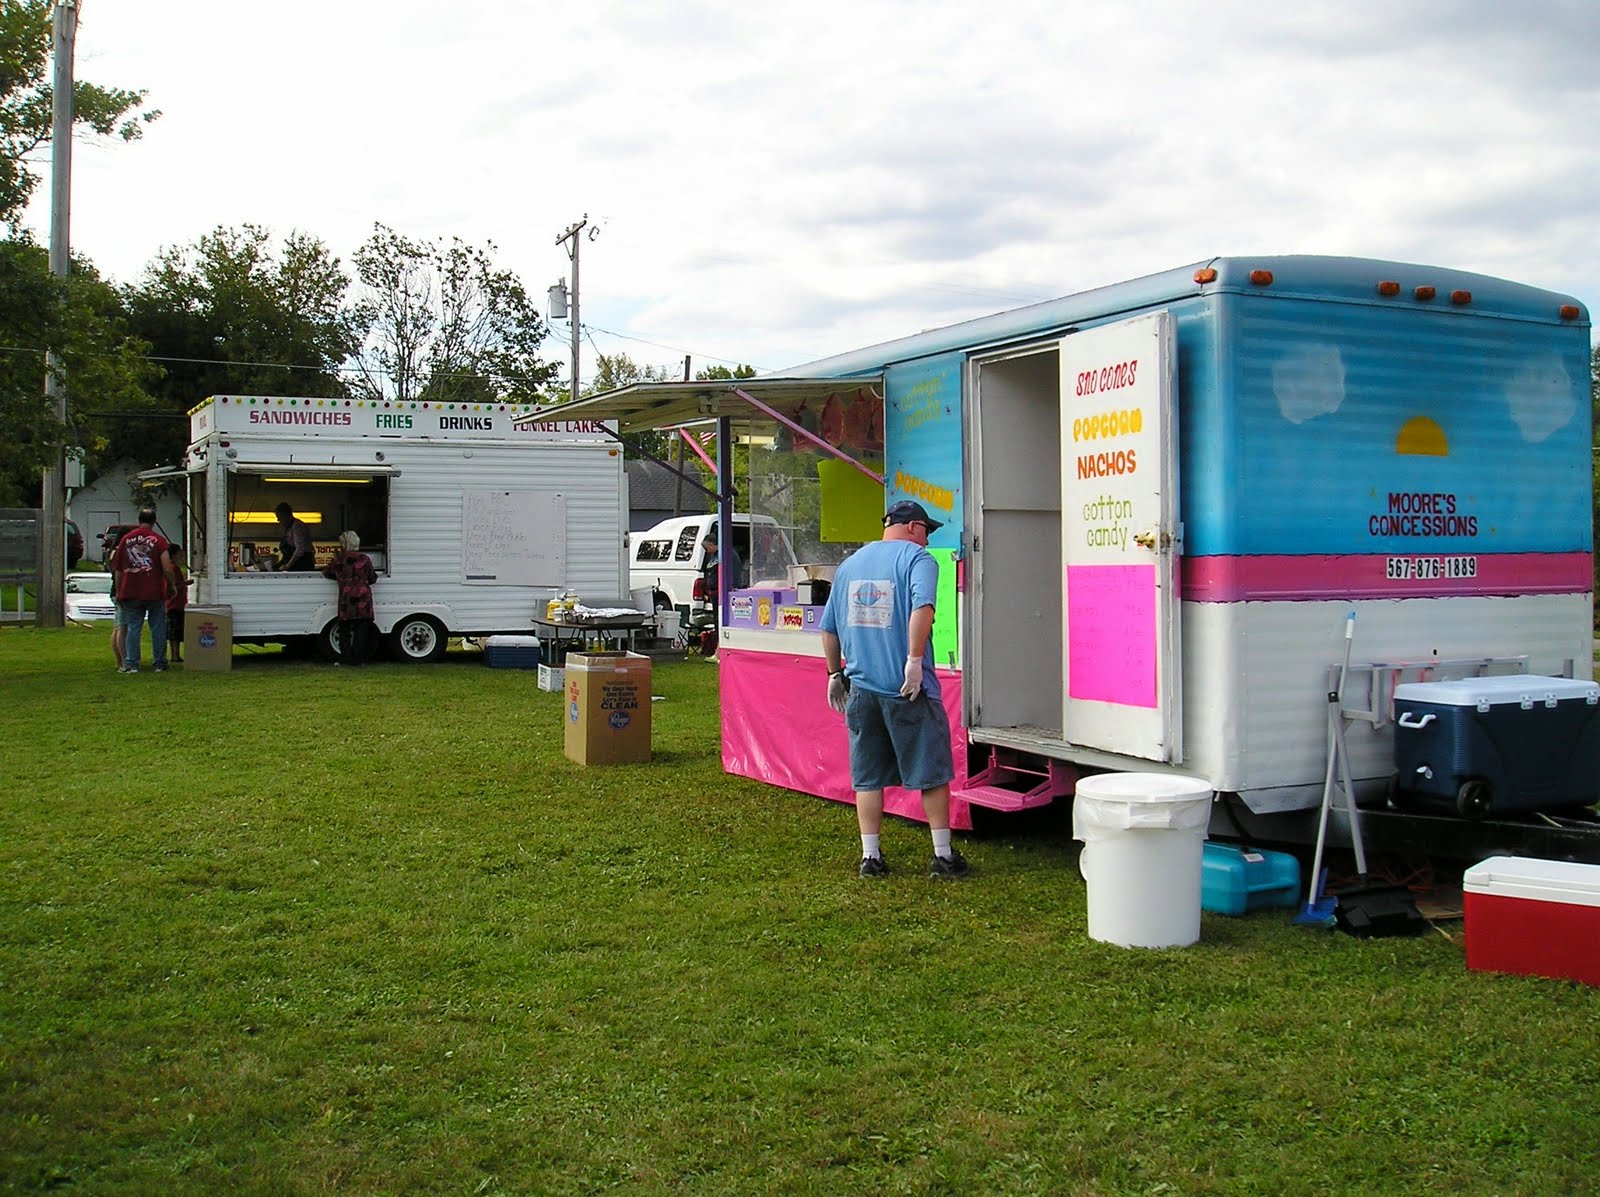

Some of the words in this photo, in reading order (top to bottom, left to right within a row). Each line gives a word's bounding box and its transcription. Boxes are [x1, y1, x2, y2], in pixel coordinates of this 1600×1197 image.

[249, 410, 351, 425] SANDWICHES
[376, 413, 413, 429] FRIES
[439, 415, 493, 431] DRINKS
[1073, 407, 1143, 443] POPCORN
[1077, 448, 1137, 480] NACHOS
[894, 470, 955, 513] POPCORN
[1388, 492, 1457, 514] MOORE'S
[1083, 494, 1132, 522] cotton
[1086, 521, 1128, 552] candy
[1368, 514, 1478, 537] CONCESSIONS
[1388, 557, 1476, 578] 567-876-1889
[601, 702, 639, 710] CLEAN
